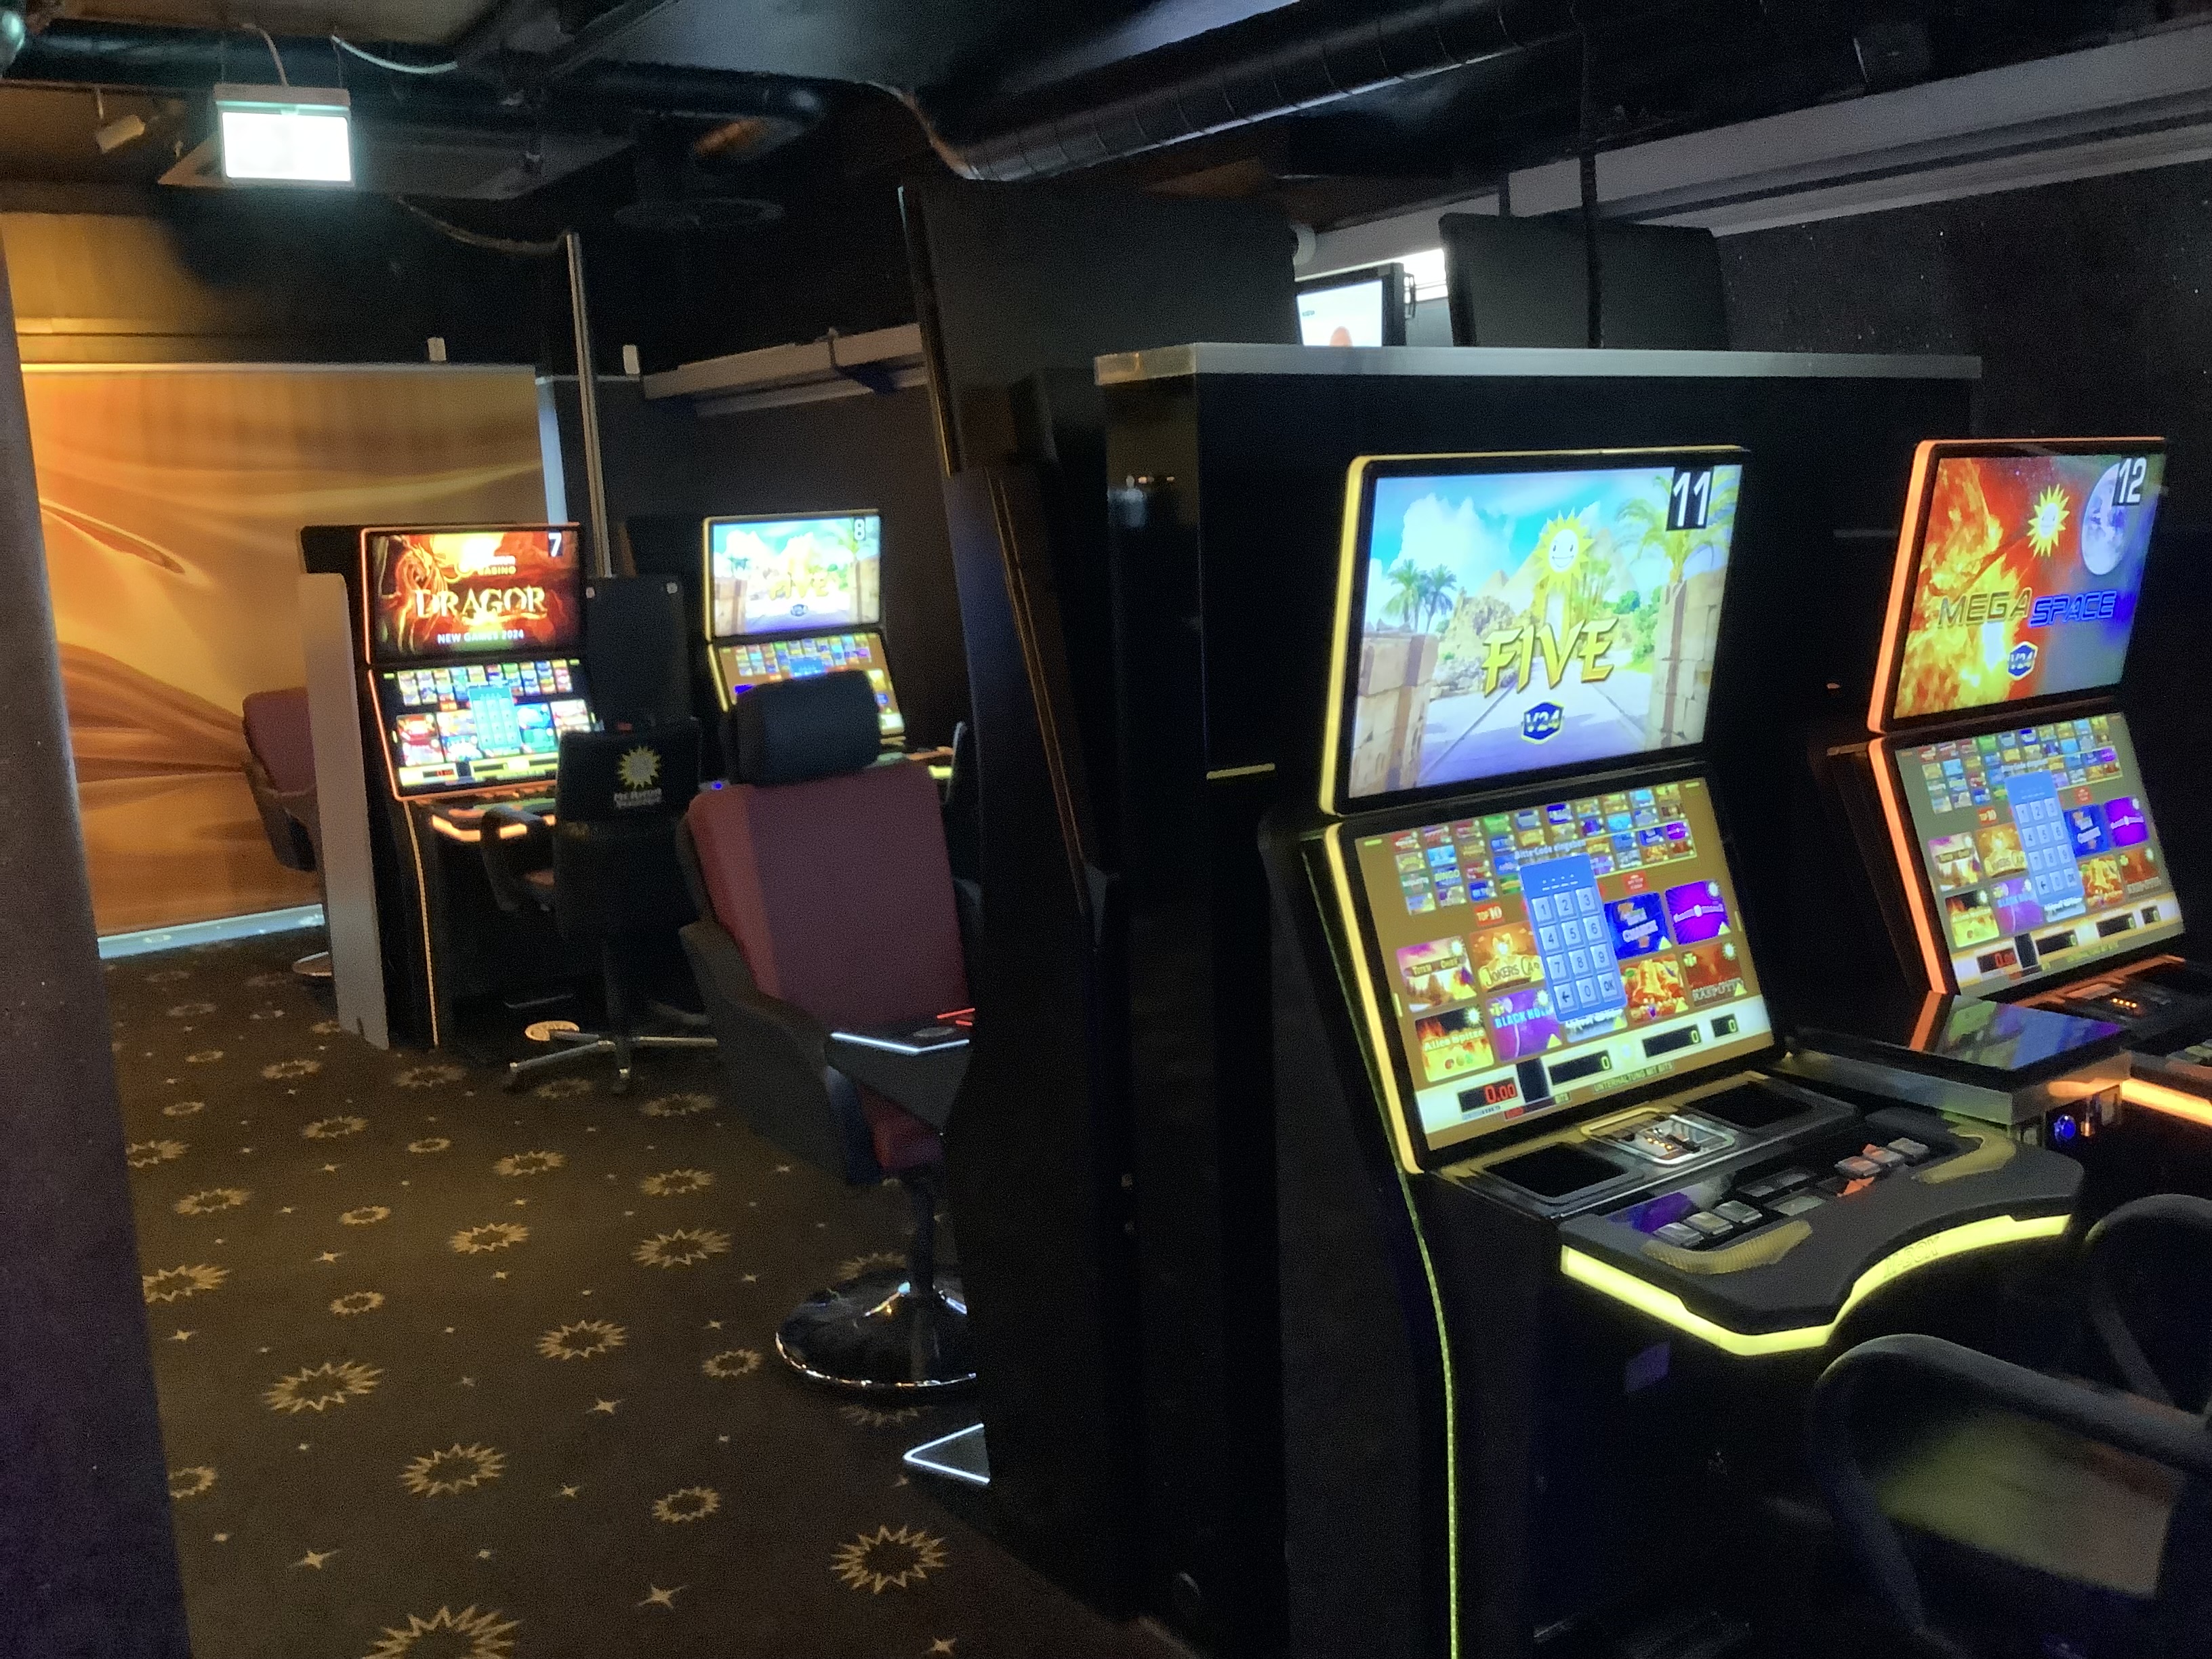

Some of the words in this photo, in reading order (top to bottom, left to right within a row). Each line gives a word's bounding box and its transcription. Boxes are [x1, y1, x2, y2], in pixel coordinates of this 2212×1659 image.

[2118, 456, 2147, 504] 12
[1673, 471, 1711, 527] 11
[854, 518, 865, 541] 8
[548, 533, 562, 557] 7
[415, 584, 546, 618] DRAGOR
[1937, 587, 2032, 629] MEGA
[2028, 590, 2117, 628] SPACE
[437, 632, 462, 644] NEW
[501, 629, 524, 640] 2024
[1481, 618, 1619, 699] FIVE
[1525, 710, 1560, 733] V24
[1488, 905, 1502, 920] 10
[1540, 903, 1547, 912] 1
[1561, 899, 1569, 912] 2
[1583, 894, 1591, 906] 3
[1548, 933, 1555, 944] 4
[1570, 927, 1576, 939] 5
[1591, 923, 1598, 935] 6
[1554, 962, 1561, 974] 7
[1576, 956, 1584, 968] 8
[1598, 951, 1605, 963] 9
[1584, 985, 1591, 998] 0
[1603, 979, 1615, 992] OK
[1494, 1009, 1525, 1029] BLACK
[1728, 1019, 1737, 1033] 0
[1690, 1029, 1700, 1044] 0
[1601, 1055, 1610, 1070] 0
[1483, 1084, 1516, 1104] 0.00
